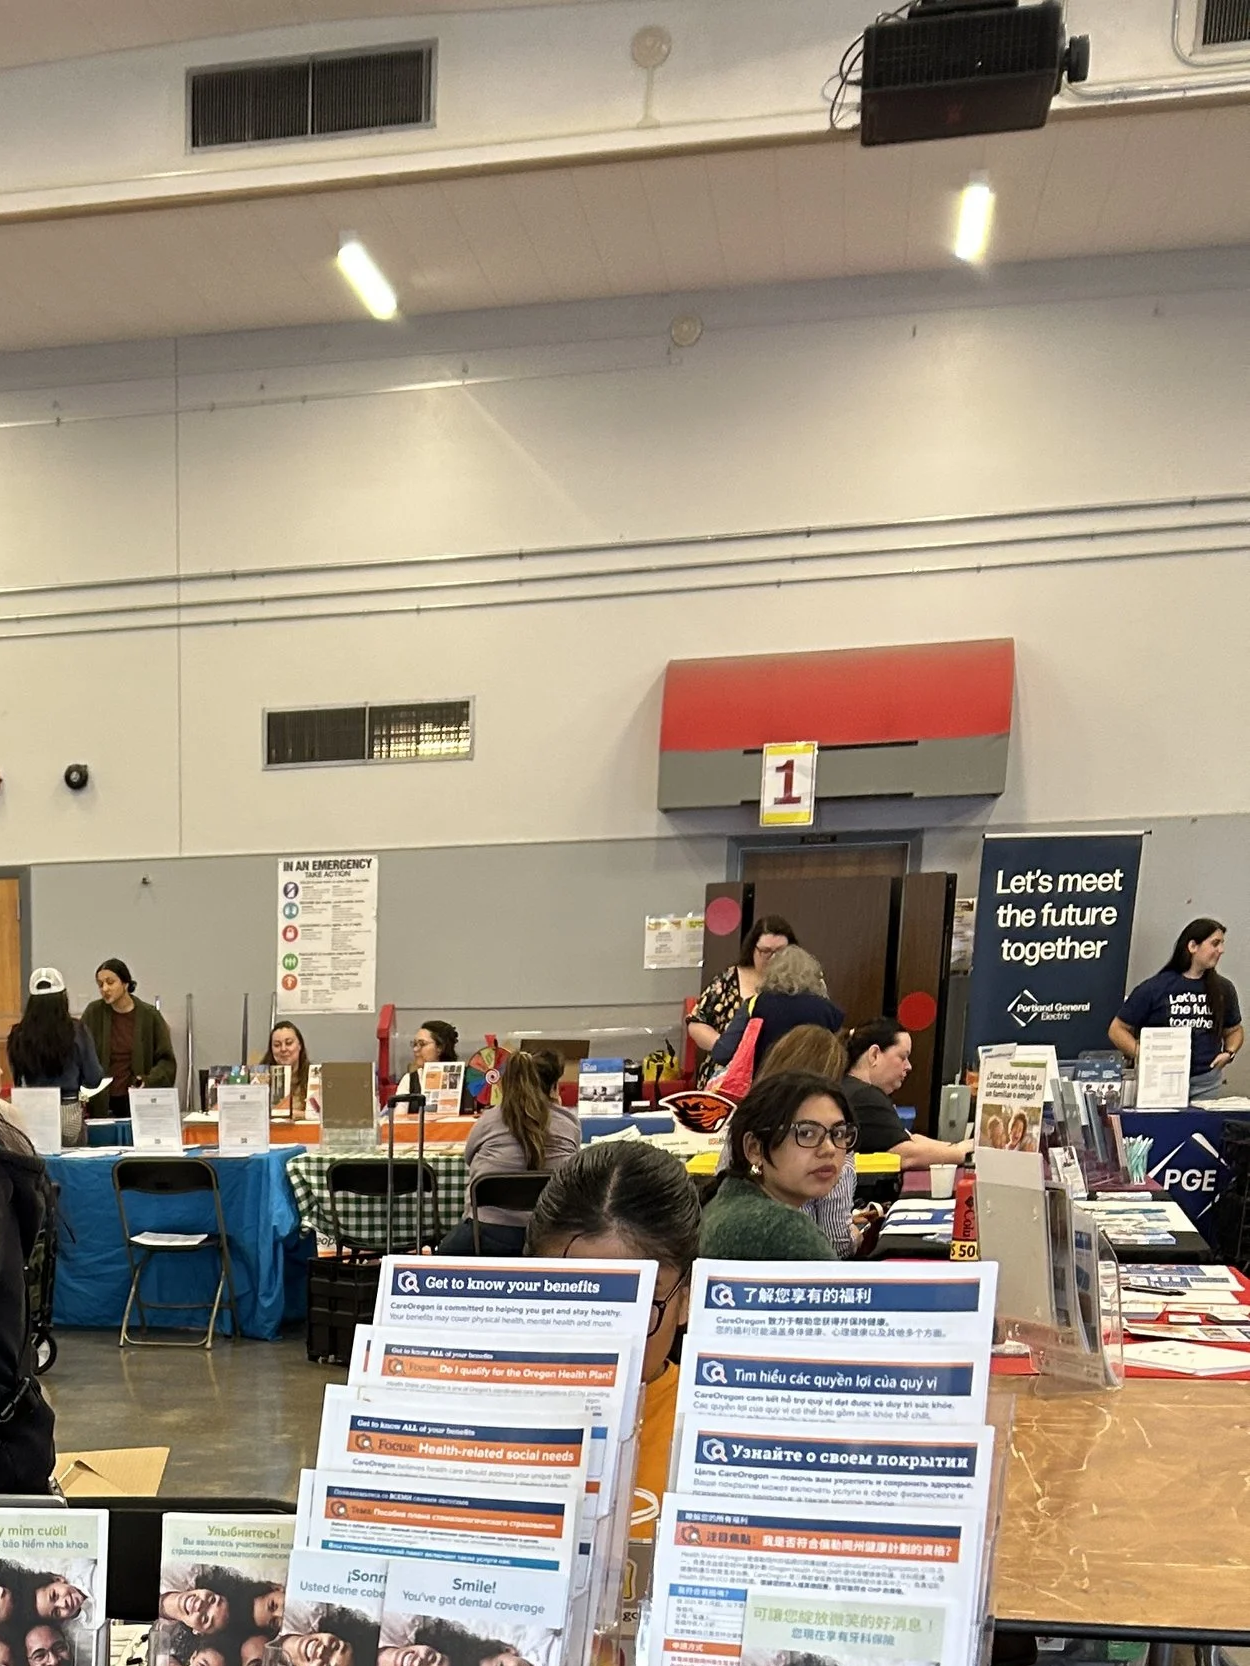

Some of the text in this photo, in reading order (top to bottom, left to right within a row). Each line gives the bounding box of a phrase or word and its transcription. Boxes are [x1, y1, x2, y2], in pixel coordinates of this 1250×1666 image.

[774, 759, 801, 805] 1
[284, 859, 372, 871] IN AN EMERGENCY
[996, 869, 1123, 894] Let's meet
[997, 903, 1117, 928] the future
[1001, 936, 1108, 966] together
[1169, 992, 1197, 1004] Let's
[1017, 1003, 1090, 1012] Portland General
[1171, 1004, 1190, 1014] the
[1041, 1012, 1070, 1021] Electric
[1019, 1073, 1029, 1081] bajo
[1163, 1169, 1217, 1192] PGE
[425, 1276, 600, 1293] Get to know your benefits
[744, 1288, 871, 1304] 了解您享有的福利
[440, 1365, 452, 1374] Do
[460, 1367, 490, 1377] qualify
[492, 1367, 504, 1376] for
[507, 1368, 521, 1377] the
[523, 1369, 556, 1379] Oregon
[558, 1370, 587, 1378] Health
[589, 1370, 613, 1379] Plan?
[760, 1369, 786, 1383] hiểu
[790, 1372, 811, 1385] các
[814, 1372, 852, 1388] quyền
[856, 1375, 871, 1389] lợi
[874, 1375, 896, 1388] của
[900, 1376, 923, 1391] quý
[927, 1376, 937, 1391] vị
[419, 1443, 504, 1459] Health-related
[507, 1448, 539, 1460] social
[542, 1451, 574, 1461] needs
[732, 1444, 968, 1470] Узнайте о своем покрытии
[47, 1540, 64, 1548] nha
[66, 1540, 88, 1549] khoa
[300, 1581, 330, 1593] Usted
[333, 1584, 358, 1595] tiene
[452, 1578, 496, 1594] Smile!
[403, 1590, 545, 1614] You've got dental coverage
